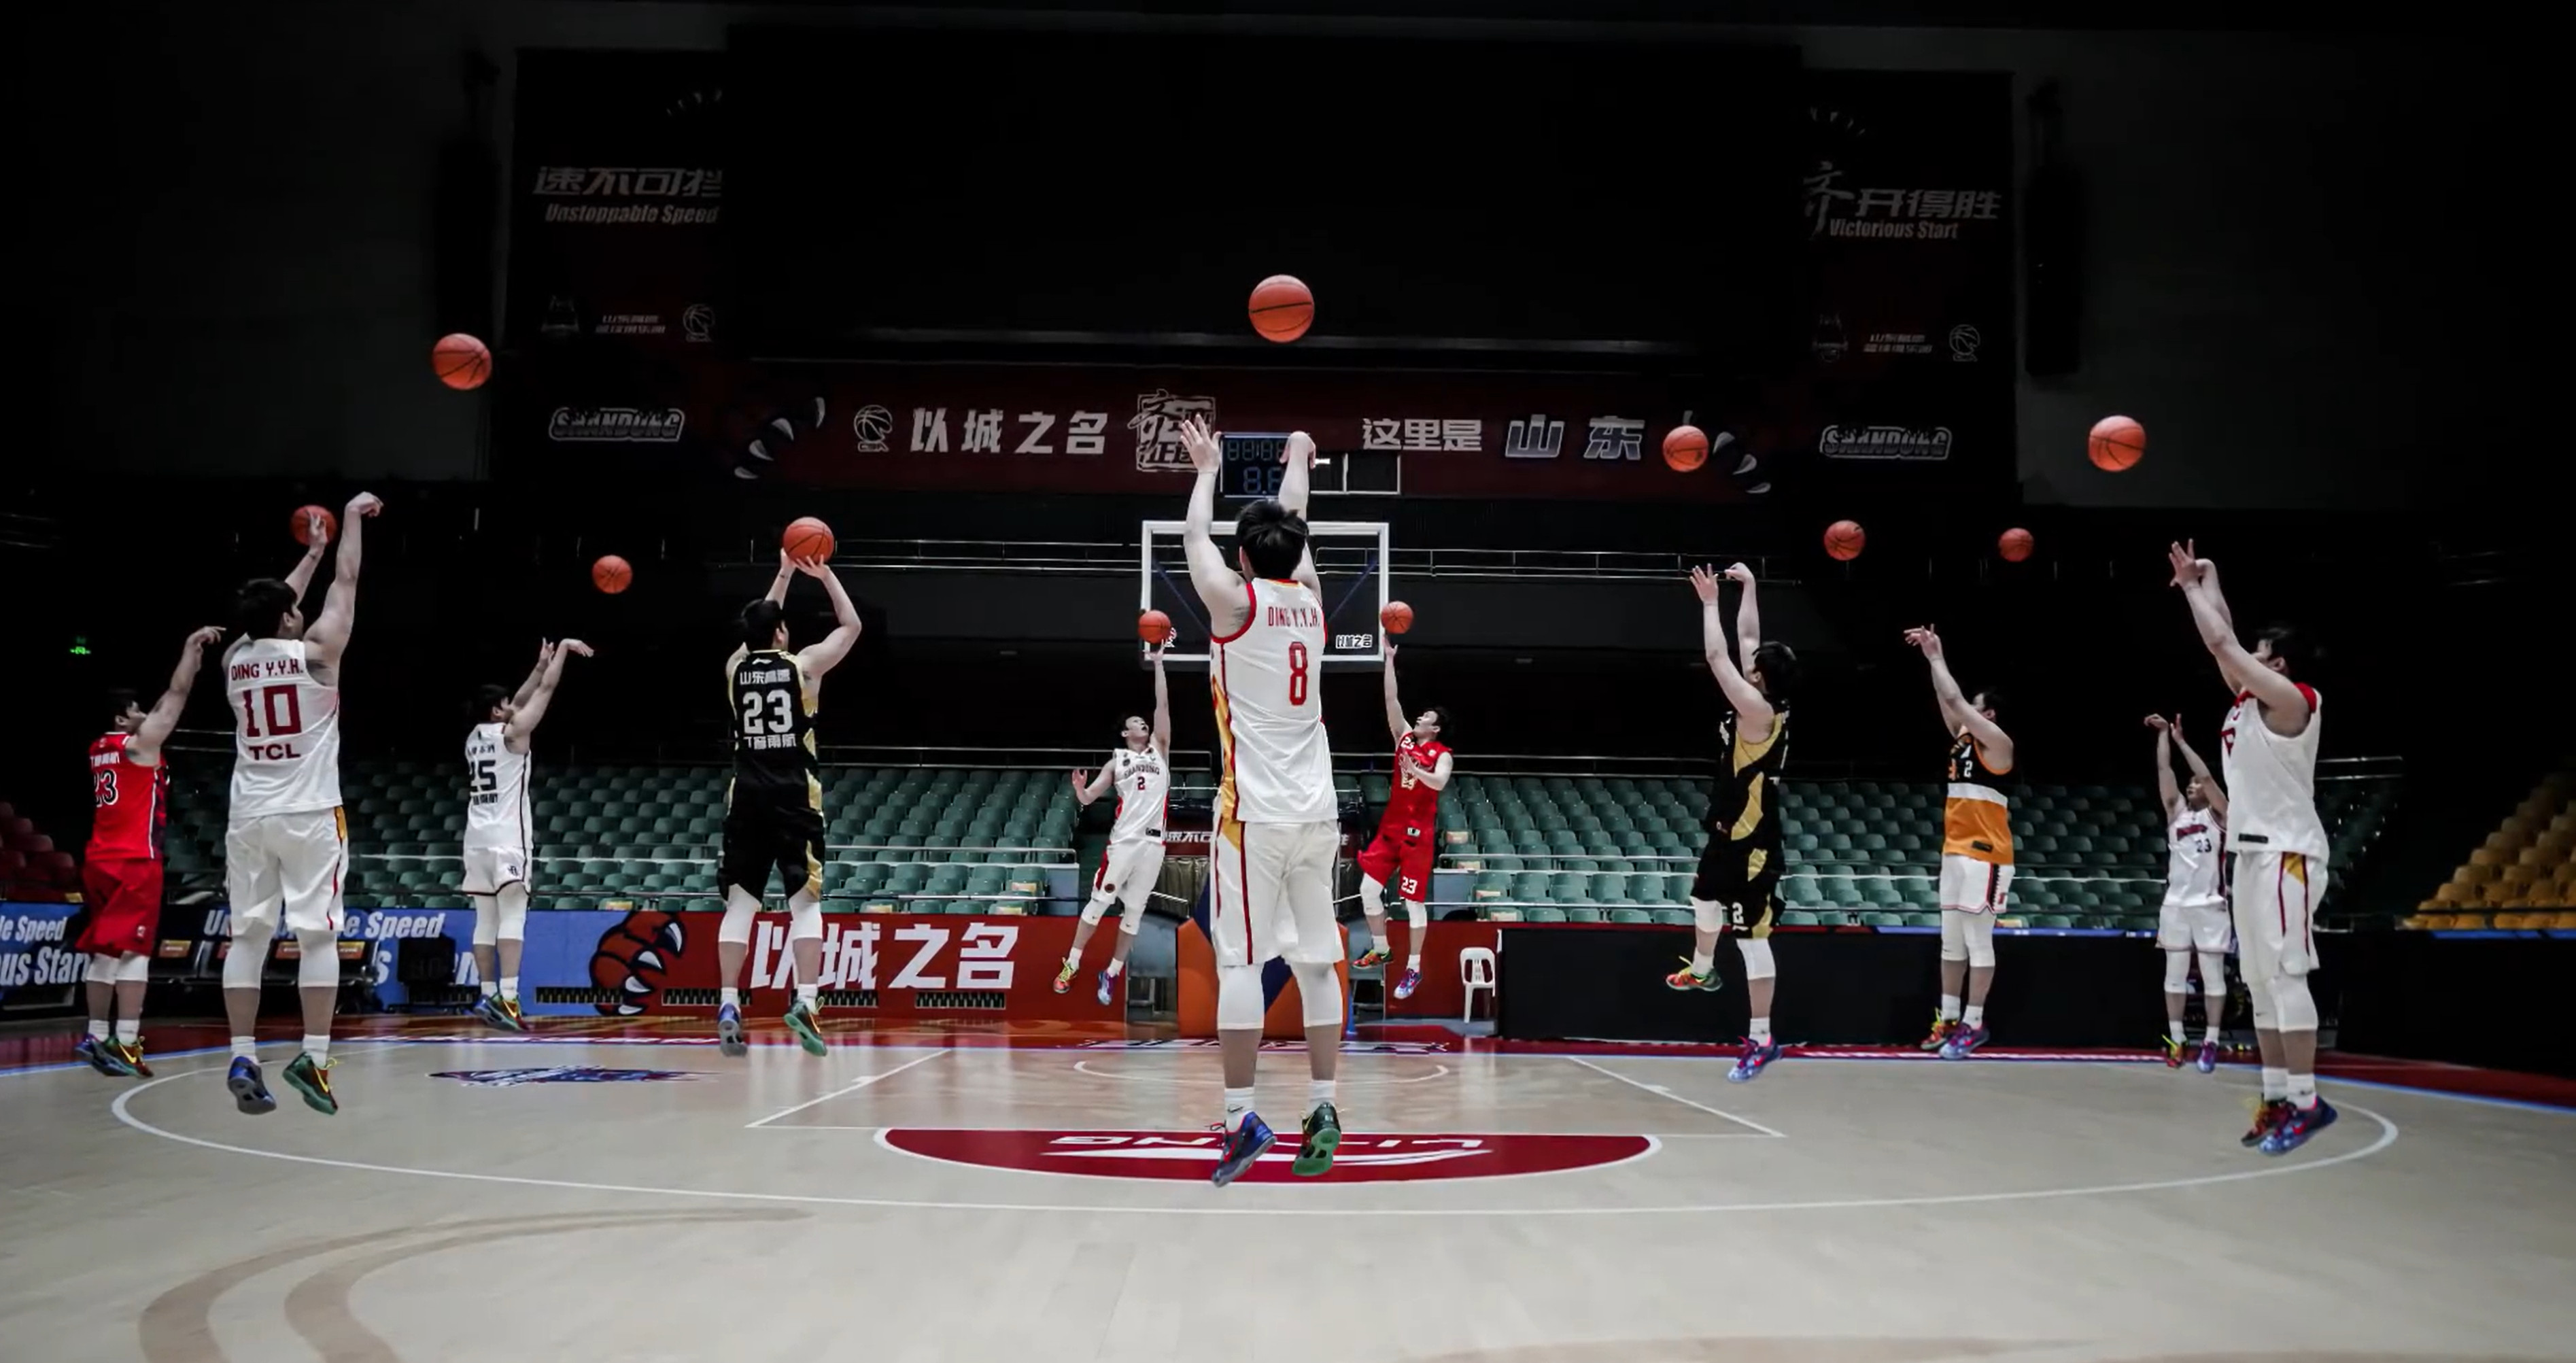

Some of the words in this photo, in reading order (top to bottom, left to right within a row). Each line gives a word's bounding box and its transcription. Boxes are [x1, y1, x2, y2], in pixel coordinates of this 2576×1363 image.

[545, 203, 658, 225] Unstoppable
[661, 203, 720, 226] Speed
[1829, 218, 1914, 239] Victorious
[1917, 220, 1959, 239] Start
[909, 408, 1107, 455] 以城之名
[1361, 418, 1482, 451] 这里是
[1503, 413, 1646, 461] 山东
[231, 663, 260, 680] DING
[266, 659, 303, 676] Y.Y.H.
[1289, 642, 1307, 706] 8
[243, 685, 301, 737] 10
[742, 689, 793, 735] 23
[249, 744, 300, 760] TCL
[1137, 776, 1146, 791] 2
[1401, 876, 1418, 895] 23
[16, 916, 68, 943] Speed
[365, 912, 445, 941] Speed
[750, 920, 1019, 990] 以城之名
